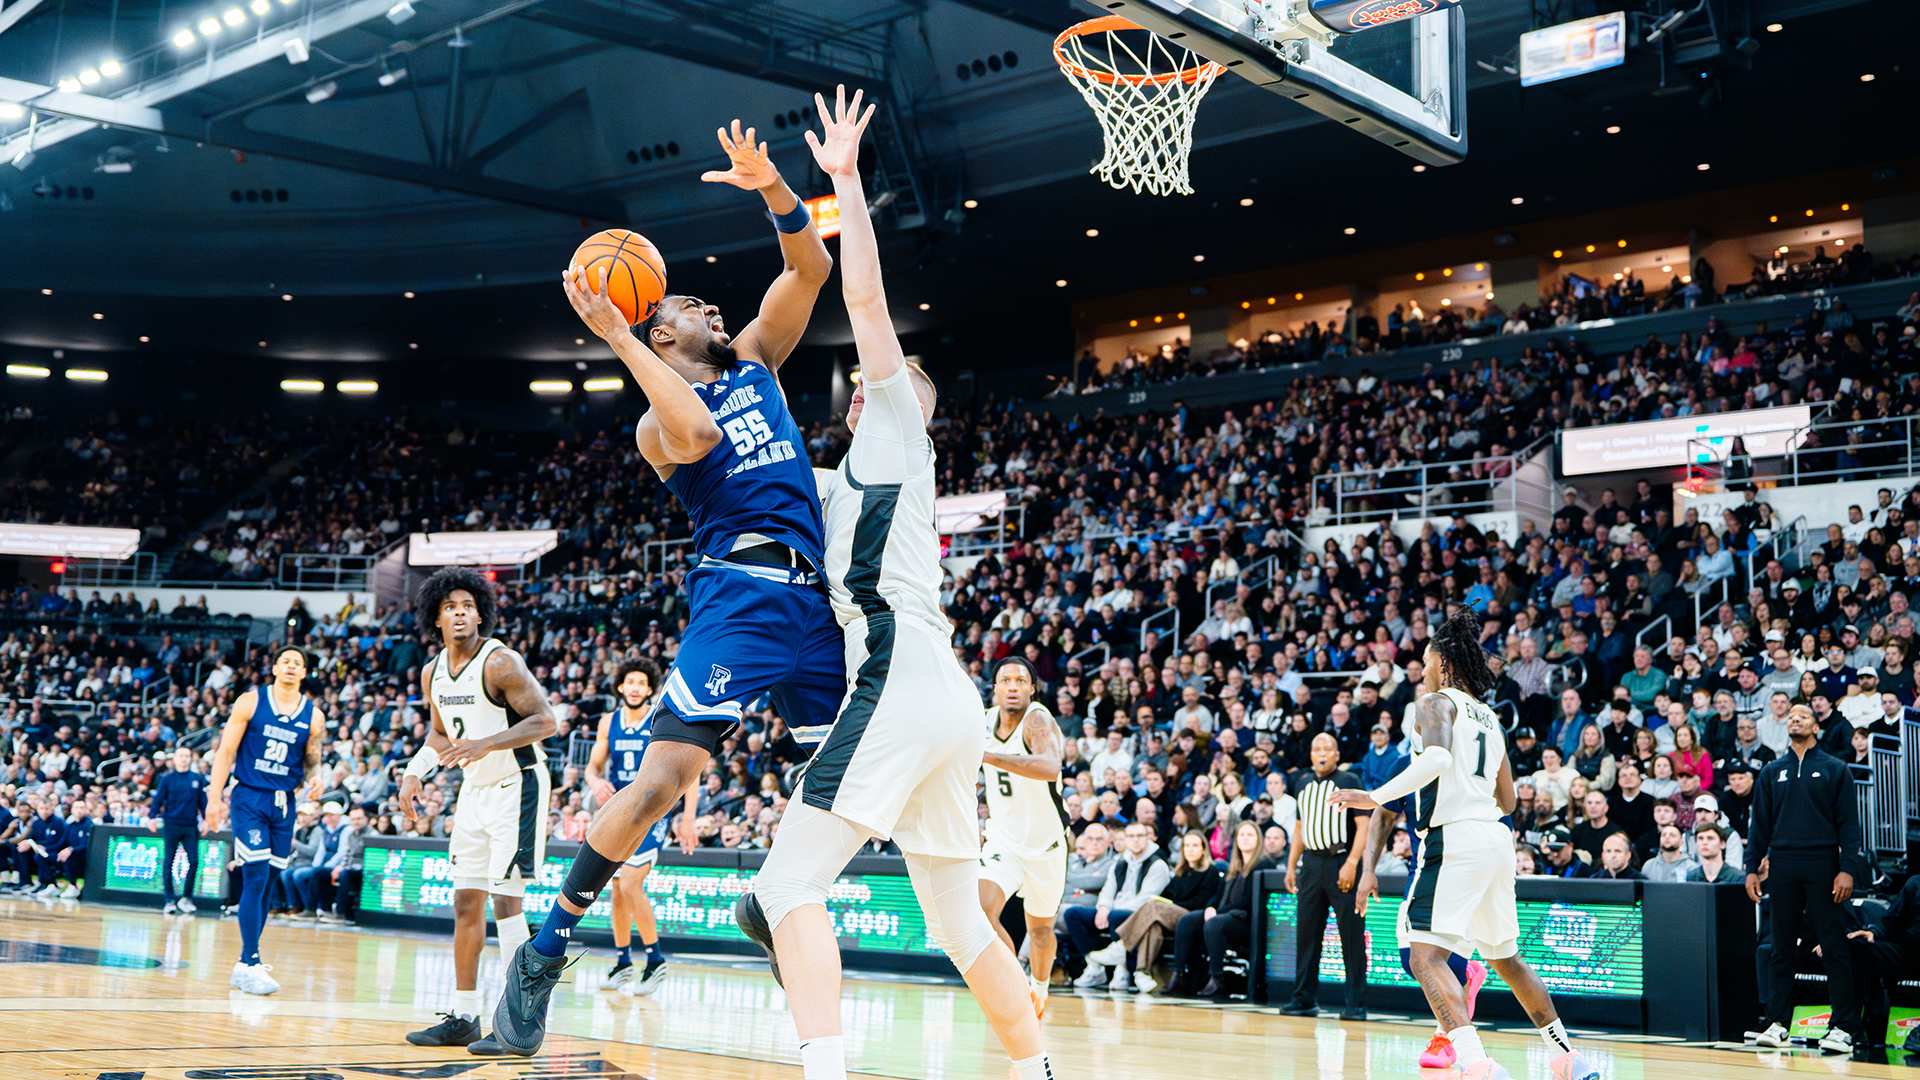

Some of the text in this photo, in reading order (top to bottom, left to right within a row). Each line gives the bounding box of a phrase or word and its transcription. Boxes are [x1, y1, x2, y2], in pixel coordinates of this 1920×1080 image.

[1358, 0, 1422, 23] Jersey
[722, 409, 774, 457] 55
[438, 694, 475, 708] PROVIDENCE
[453, 717, 465, 740] 2
[263, 738, 289, 764] 20
[1471, 729, 1487, 780] 1
[997, 771, 1013, 797] 5
